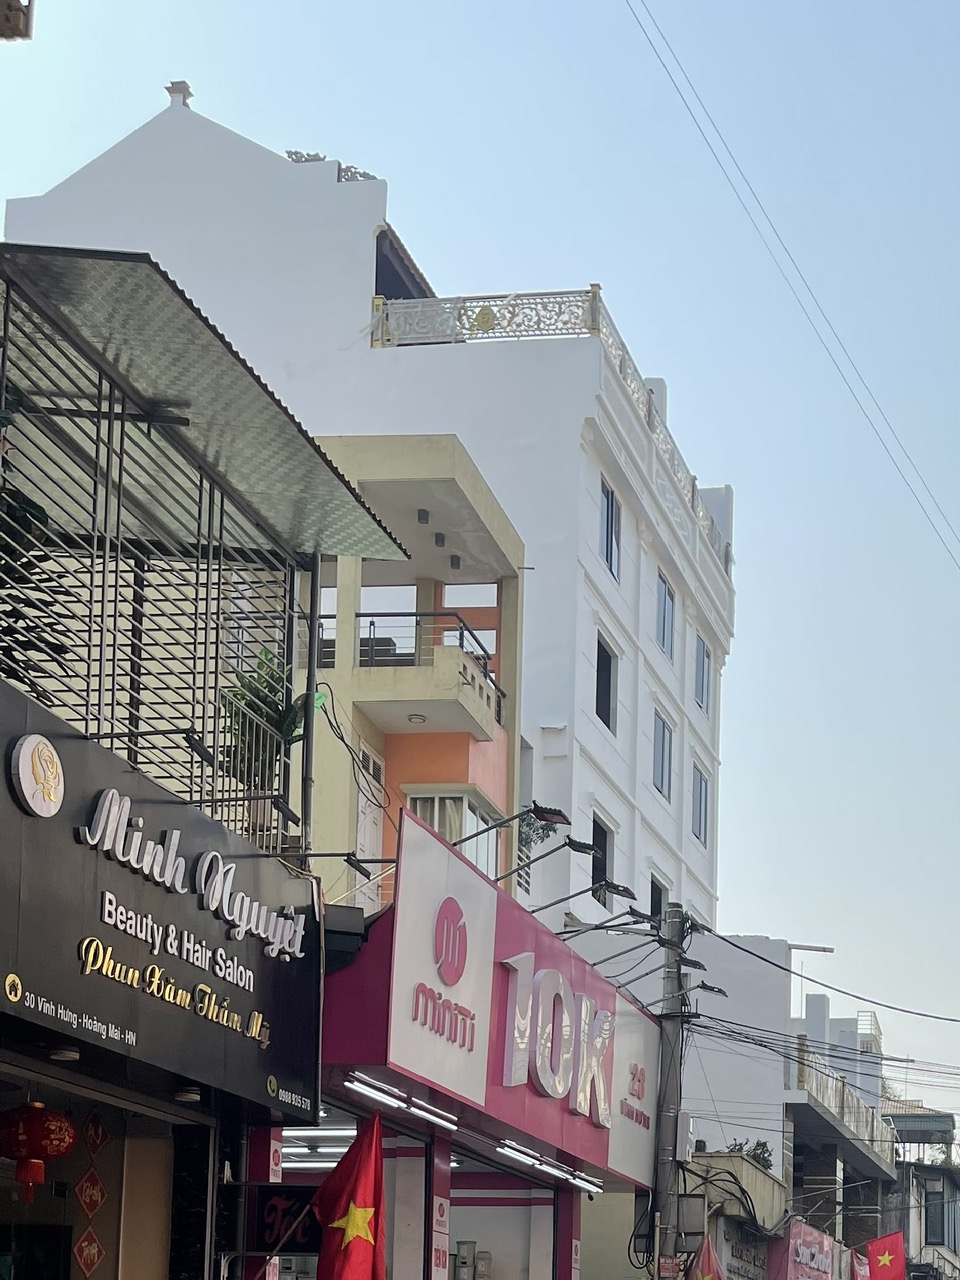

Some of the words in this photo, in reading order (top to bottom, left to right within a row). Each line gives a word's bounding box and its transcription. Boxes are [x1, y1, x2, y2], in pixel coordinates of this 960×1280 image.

[78, 788, 188, 894] Minh
[196, 851, 305, 961] Nguyệt
[81, 937, 140, 988] Phun
[102, 890, 163, 955] Beauty
[166, 924, 179, 956] &
[182, 931, 212, 971] Hair
[214, 948, 254, 992] Salon
[24, 991, 35, 1009] 30
[38, 996, 55, 1017] Vĩnh
[58, 1003, 77, 1029] Hưng
[83, 1013, 106, 1040] Hoàng
[108, 1023, 120, 1041] Mai
[125, 1029, 136, 1047] HN
[501, 951, 617, 1130] 10K
